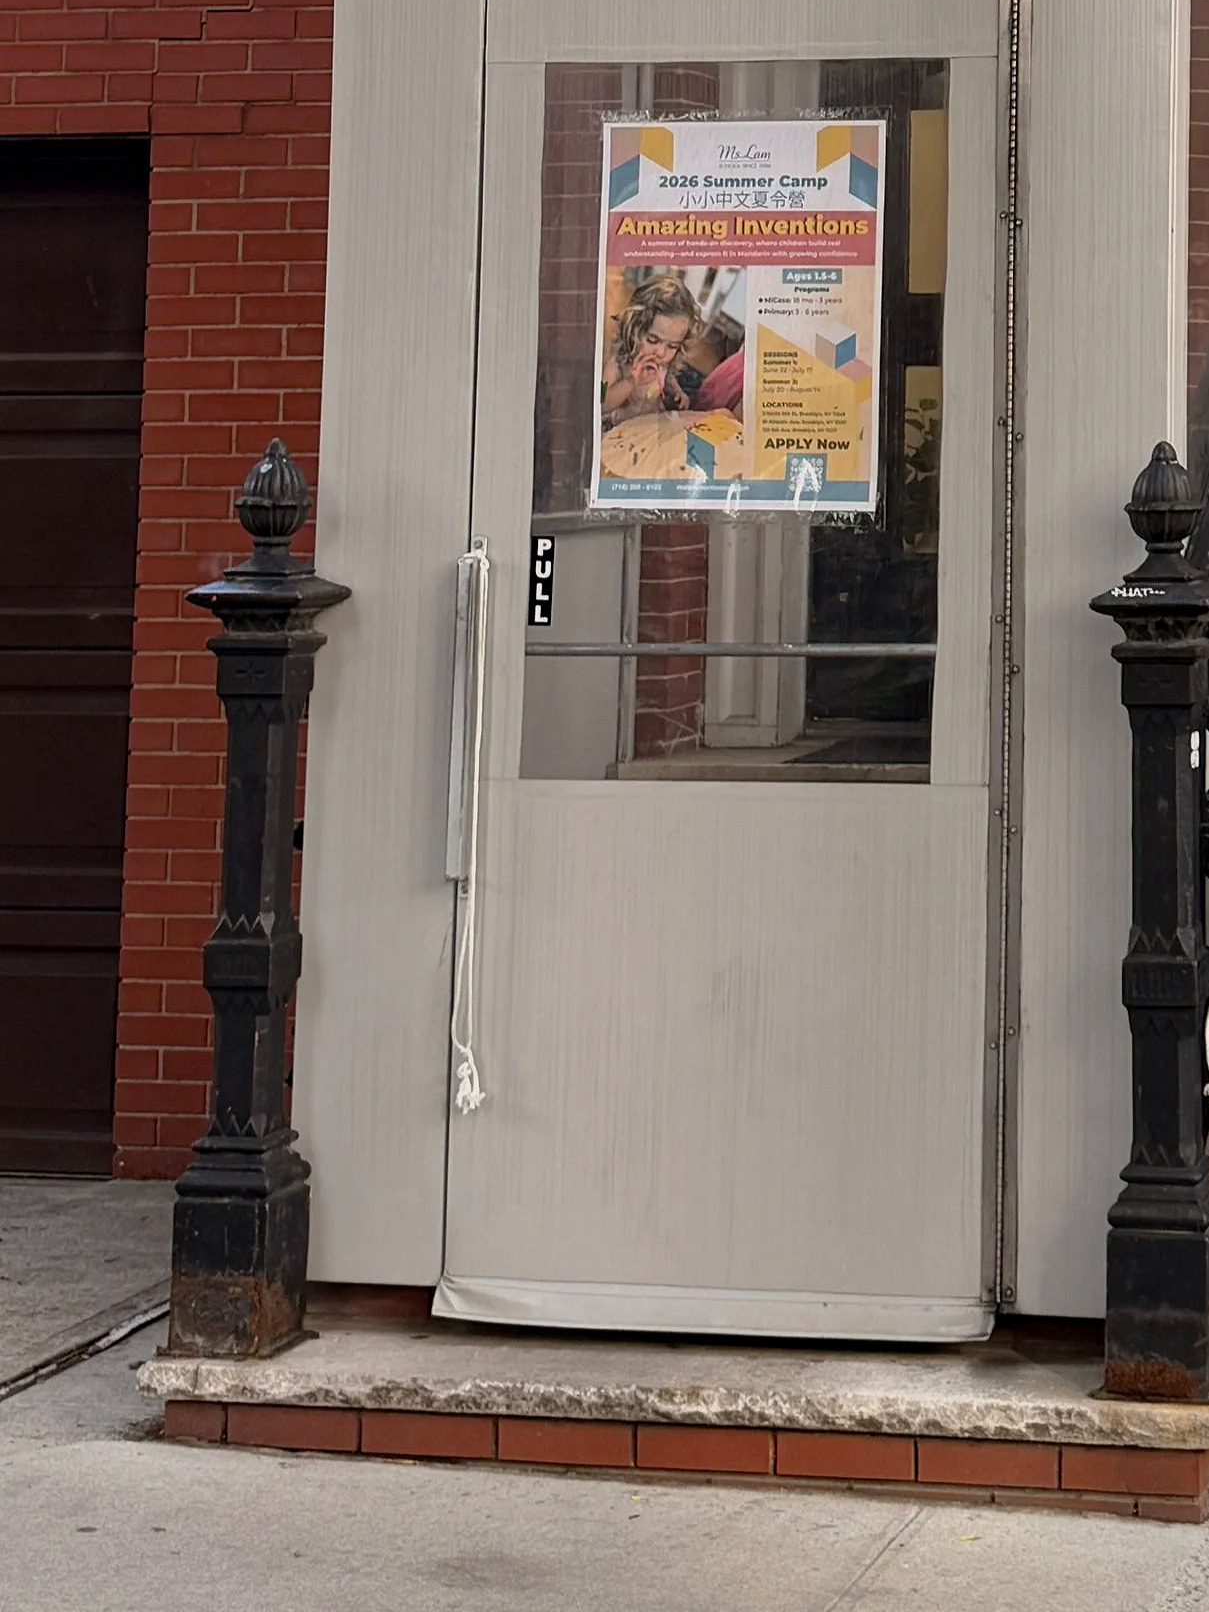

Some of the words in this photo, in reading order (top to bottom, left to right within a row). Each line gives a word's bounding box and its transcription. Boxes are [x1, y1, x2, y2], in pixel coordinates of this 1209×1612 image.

[659, 175, 699, 188] 2026
[703, 175, 775, 188] Summer
[779, 175, 828, 190] Camp
[679, 190, 806, 209] 小小中文夏令營
[617, 216, 728, 238] Amazing
[734, 214, 869, 236] Inventions
[786, 272, 812, 282] Ages
[814, 272, 838, 281] 1.5-6
[764, 437, 812, 449] APPLY
[817, 438, 850, 450] Now
[534, 538, 552, 623] PULL
